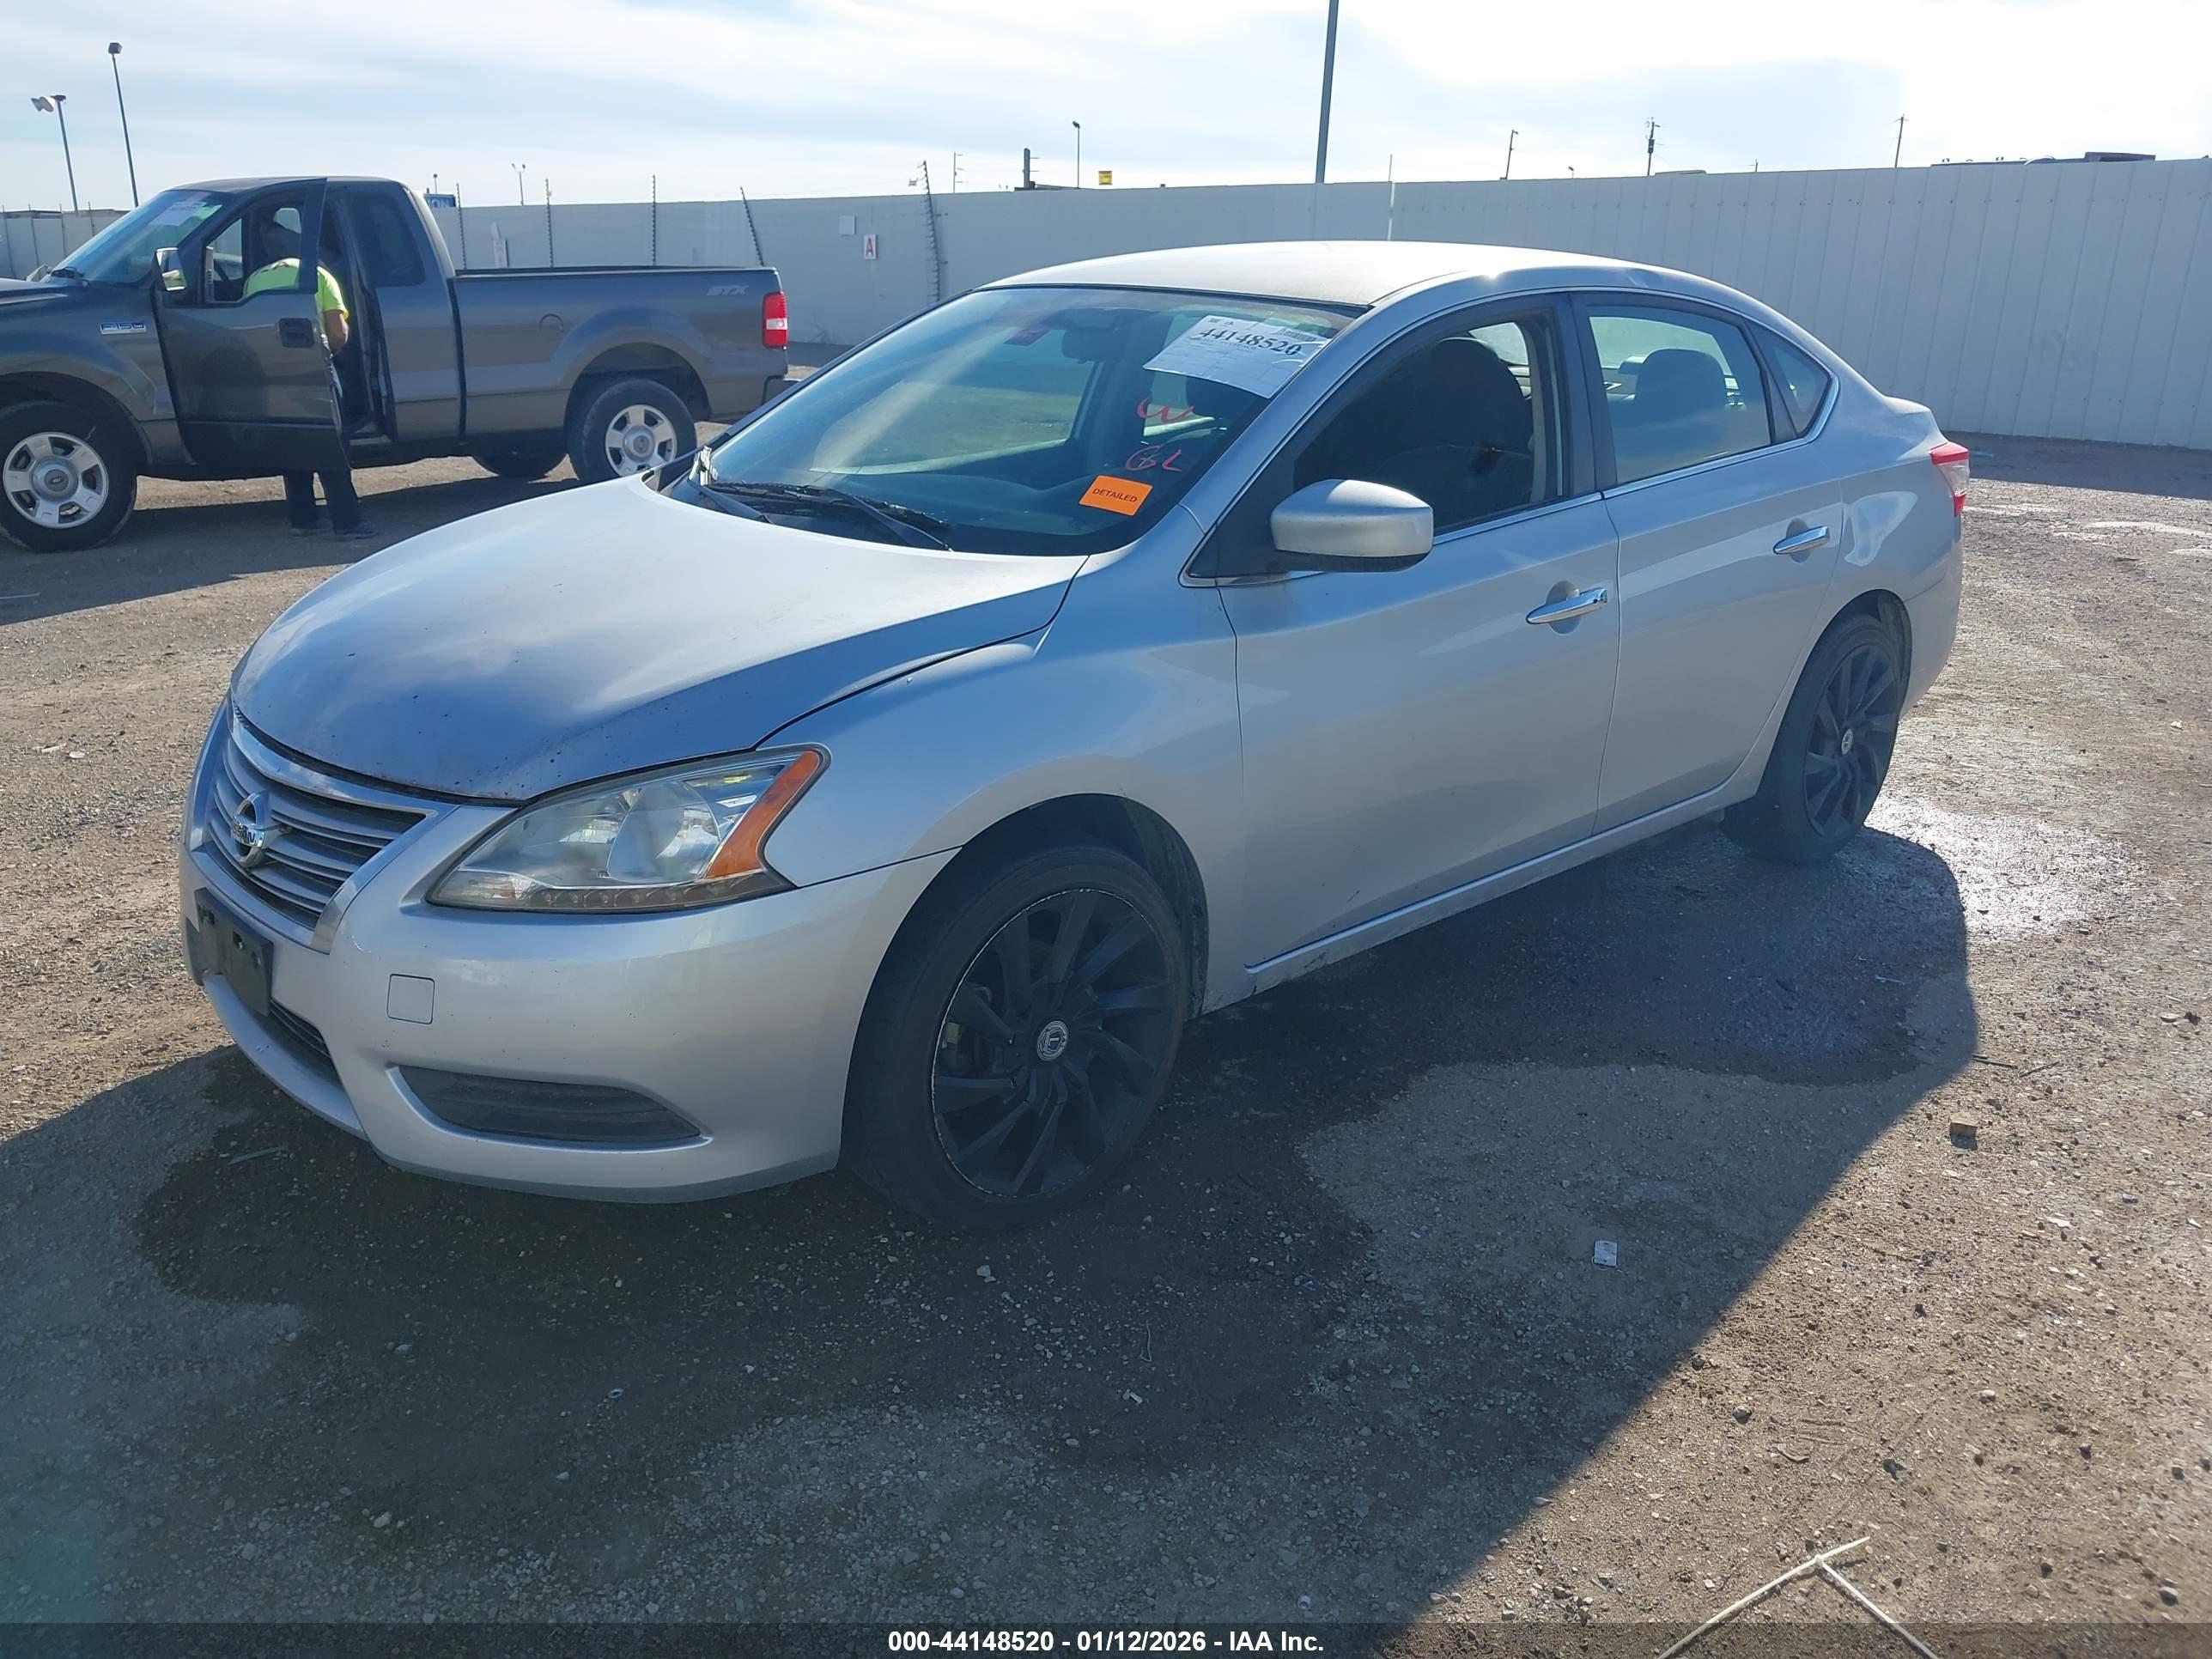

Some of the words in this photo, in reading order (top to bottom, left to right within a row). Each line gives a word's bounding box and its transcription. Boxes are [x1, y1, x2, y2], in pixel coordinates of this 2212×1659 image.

[865, 236, 874, 258] A
[1199, 328, 1303, 356] 44148520
[1092, 488, 1138, 502] DETAILED
